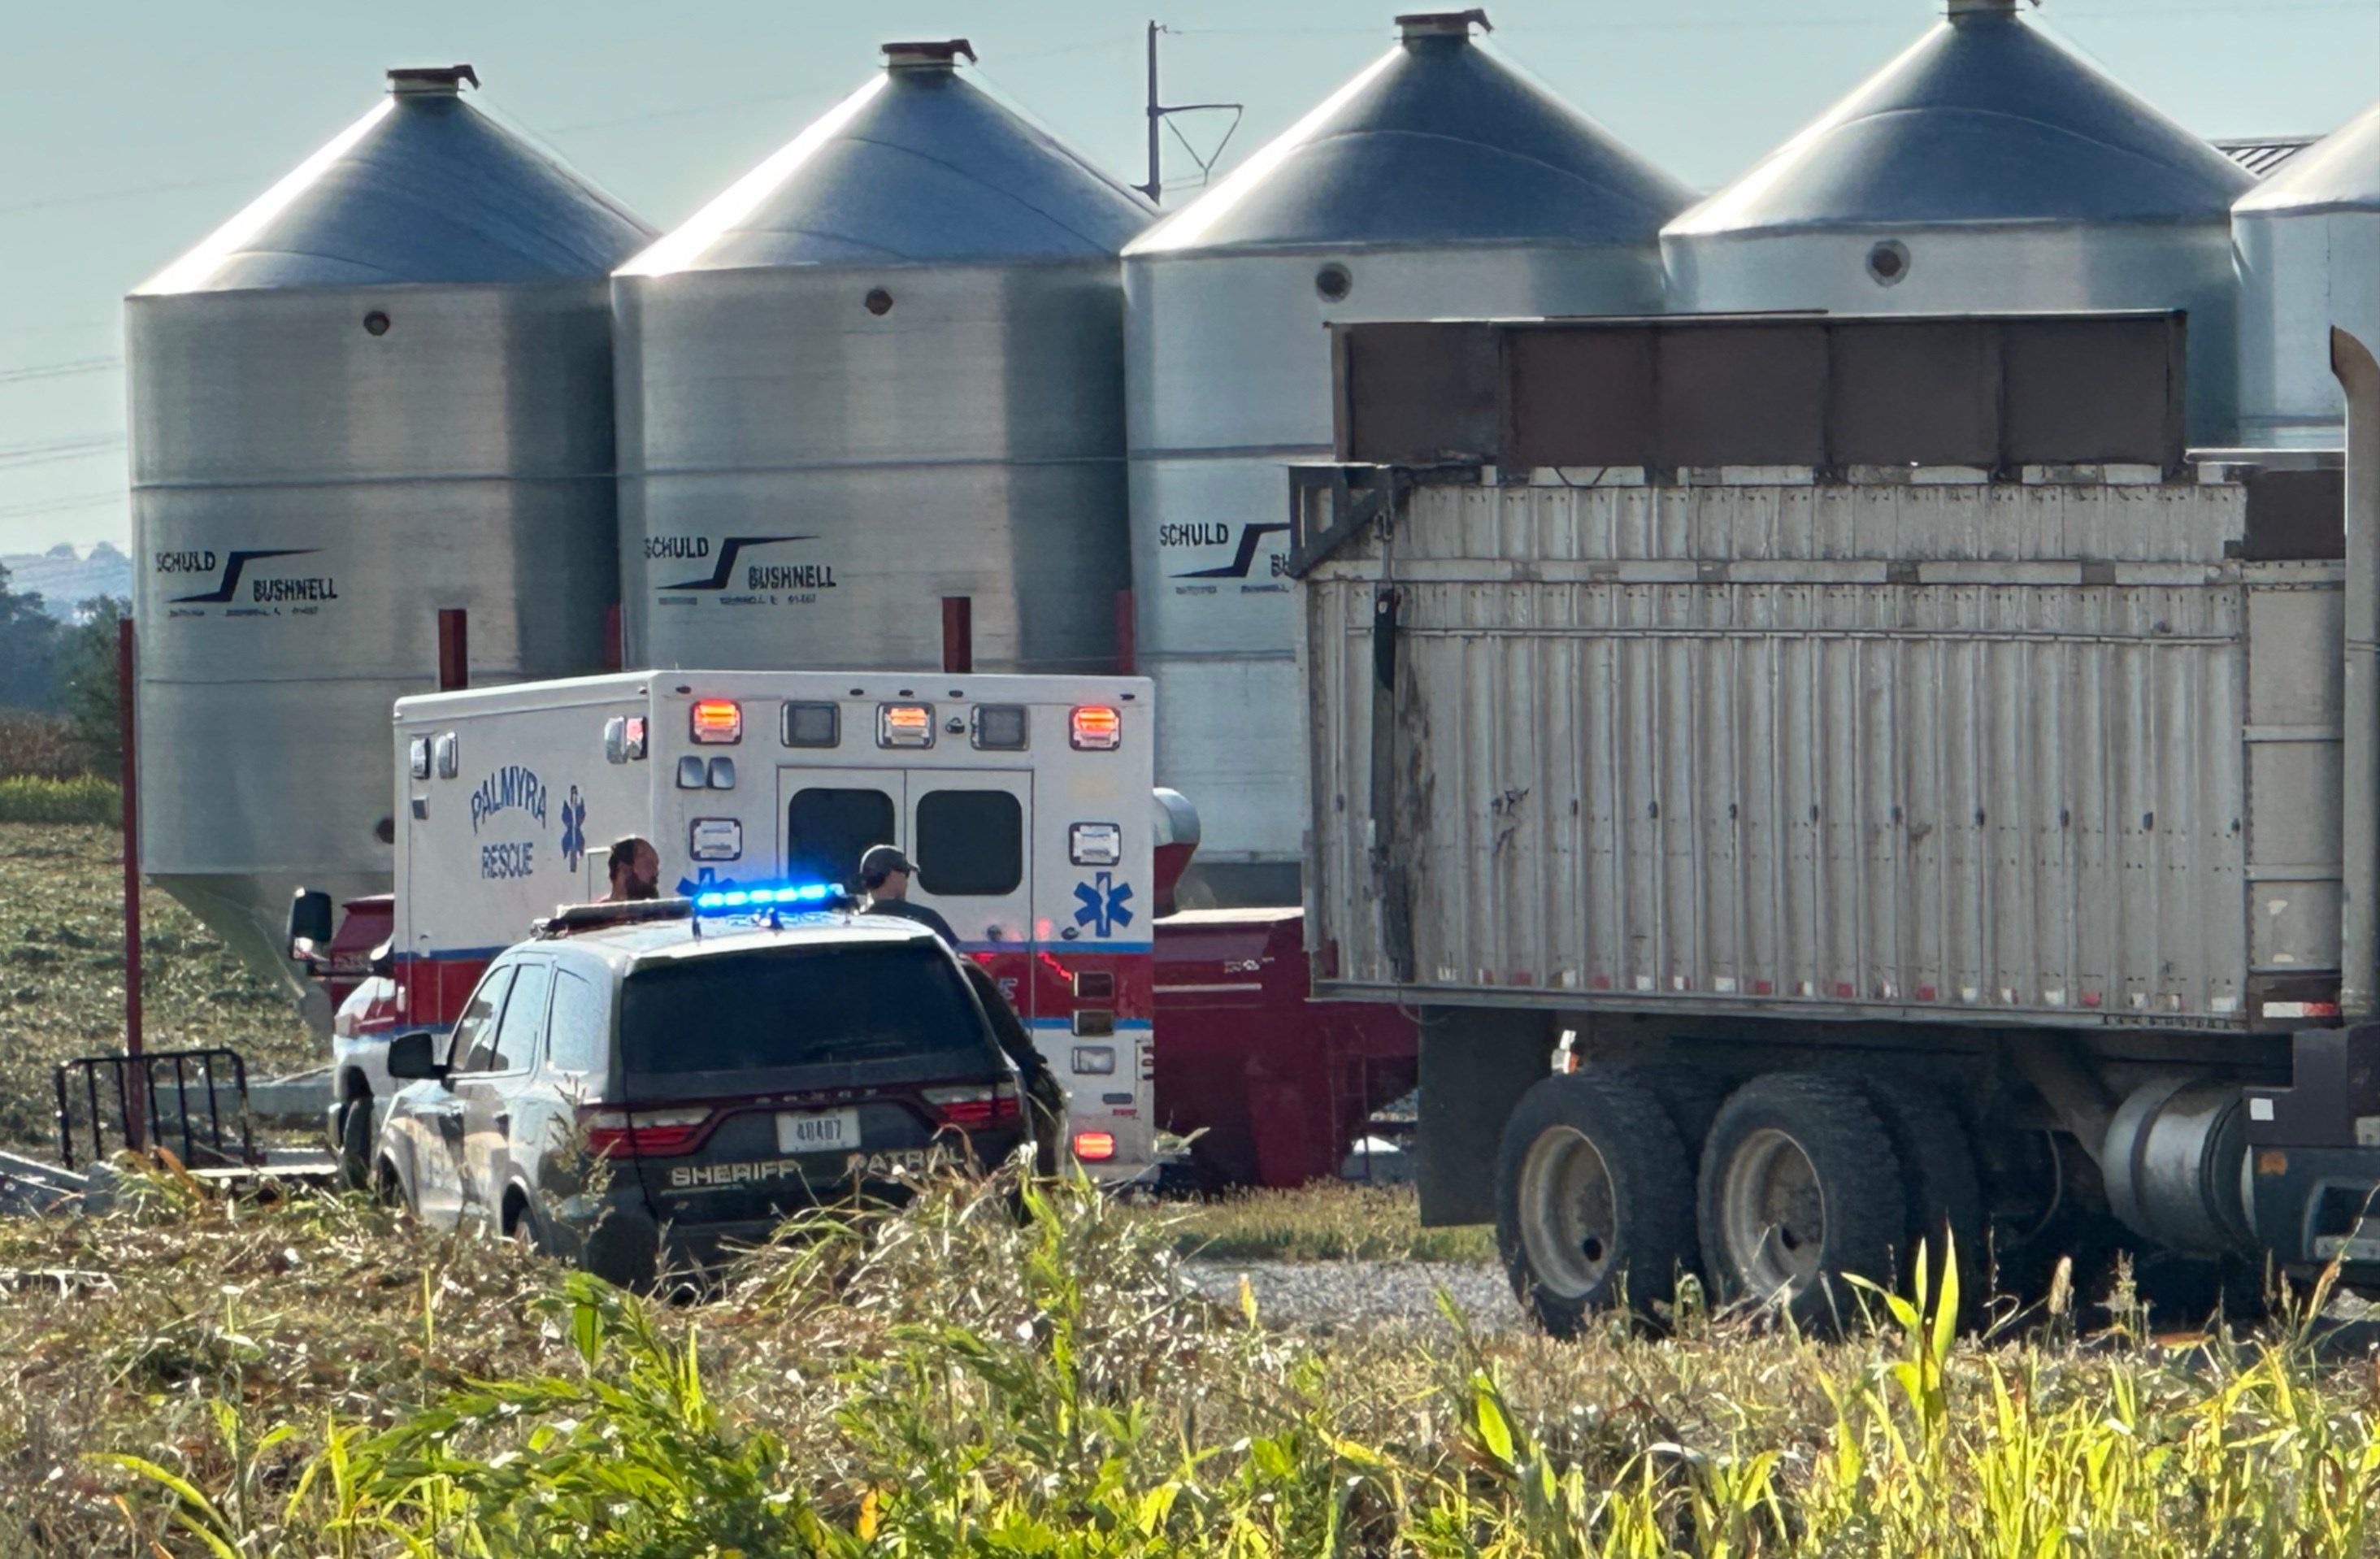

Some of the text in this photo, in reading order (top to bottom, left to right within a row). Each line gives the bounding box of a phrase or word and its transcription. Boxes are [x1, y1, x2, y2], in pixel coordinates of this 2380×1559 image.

[1159, 523, 1229, 546] SCHULD
[644, 536, 709, 559] SCHULD
[156, 550, 216, 572] SCHULD
[253, 578, 338, 602] BUSHNELL
[748, 566, 836, 590] BUSHNELL
[471, 766, 547, 836] PALMYRA
[481, 841, 533, 879] RESCUE
[671, 1159, 800, 1187] SHERIFF
